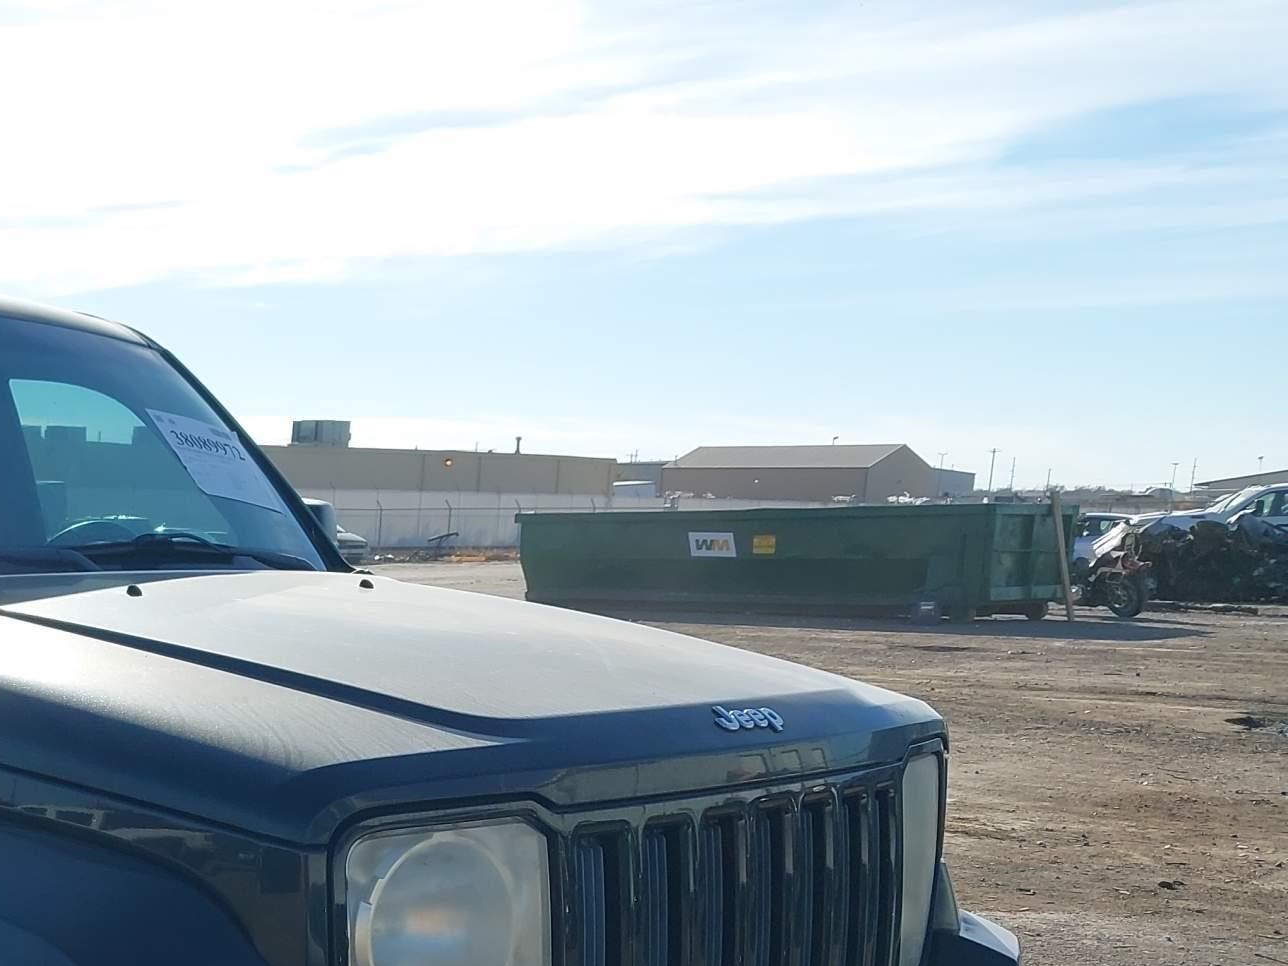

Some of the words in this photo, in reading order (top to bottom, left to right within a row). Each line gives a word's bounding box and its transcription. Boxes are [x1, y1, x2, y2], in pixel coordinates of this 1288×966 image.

[169, 429, 247, 463] 38089972
[694, 538, 731, 552] WM
[712, 705, 785, 732] Jeep
